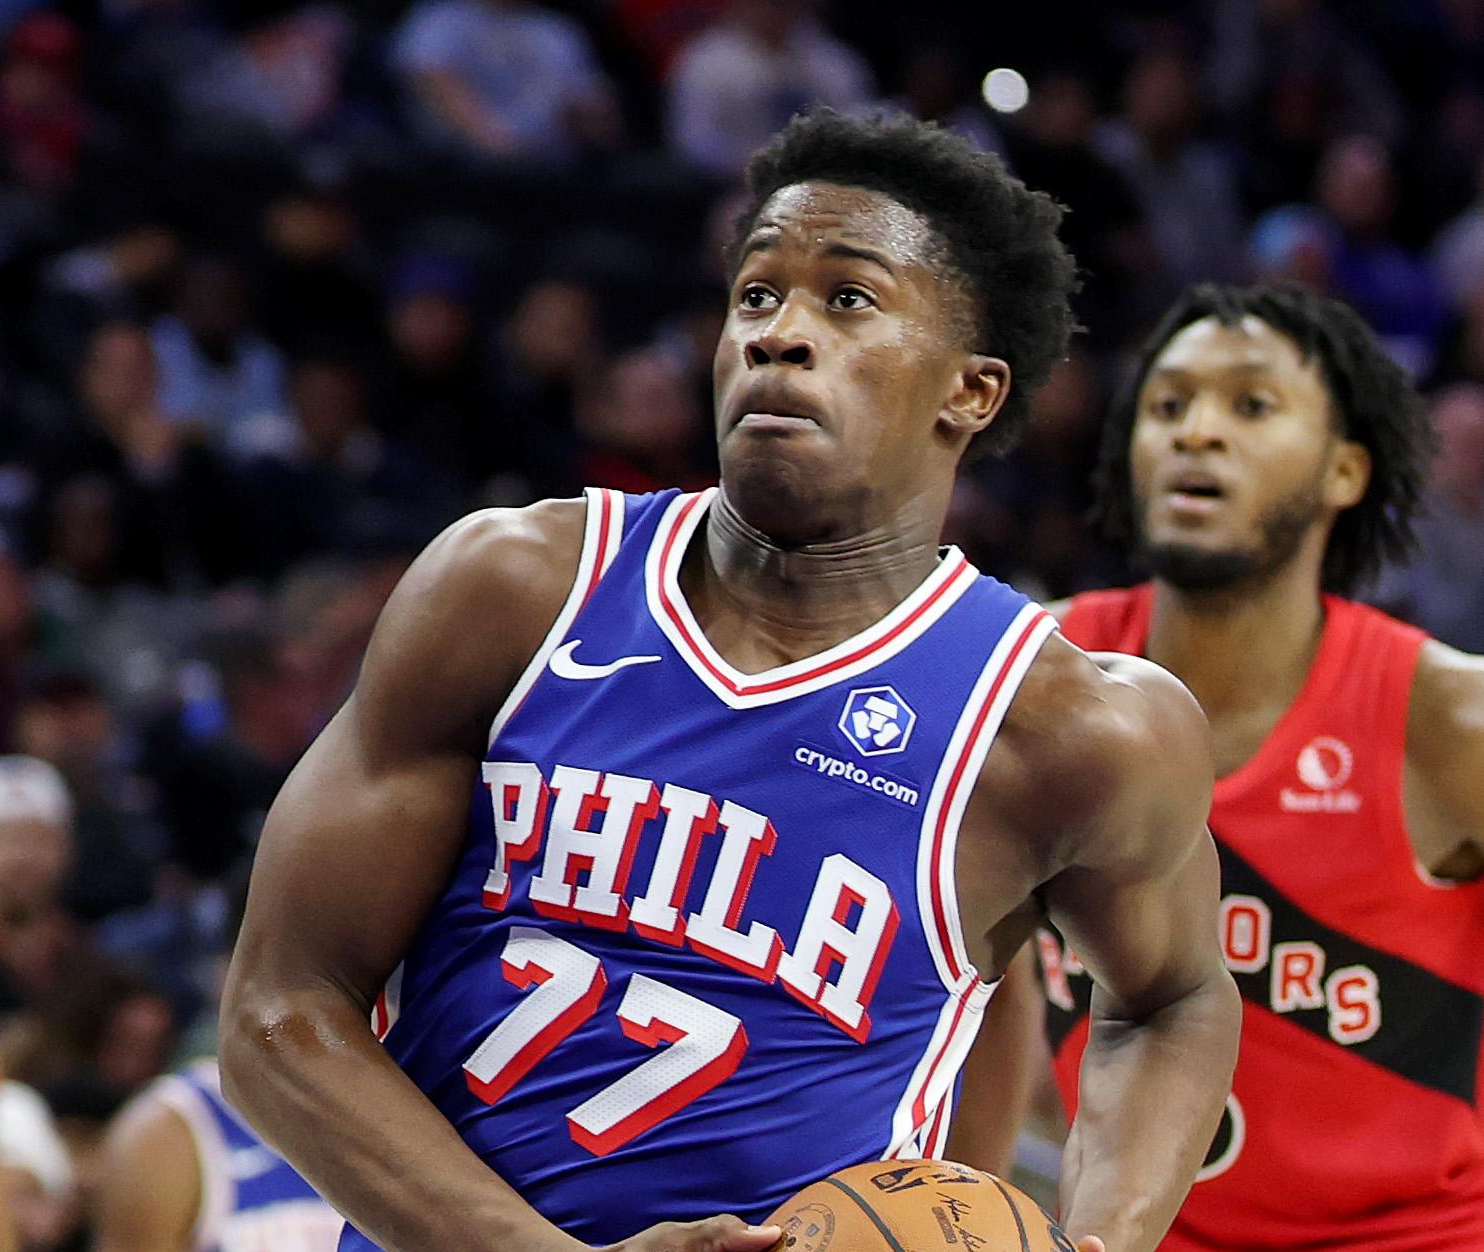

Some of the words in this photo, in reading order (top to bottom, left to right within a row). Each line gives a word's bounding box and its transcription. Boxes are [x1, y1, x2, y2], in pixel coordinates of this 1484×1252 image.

[794, 747, 919, 806] crypto.com
[481, 761, 900, 1044] PHILA
[462, 926, 748, 1156] 77
